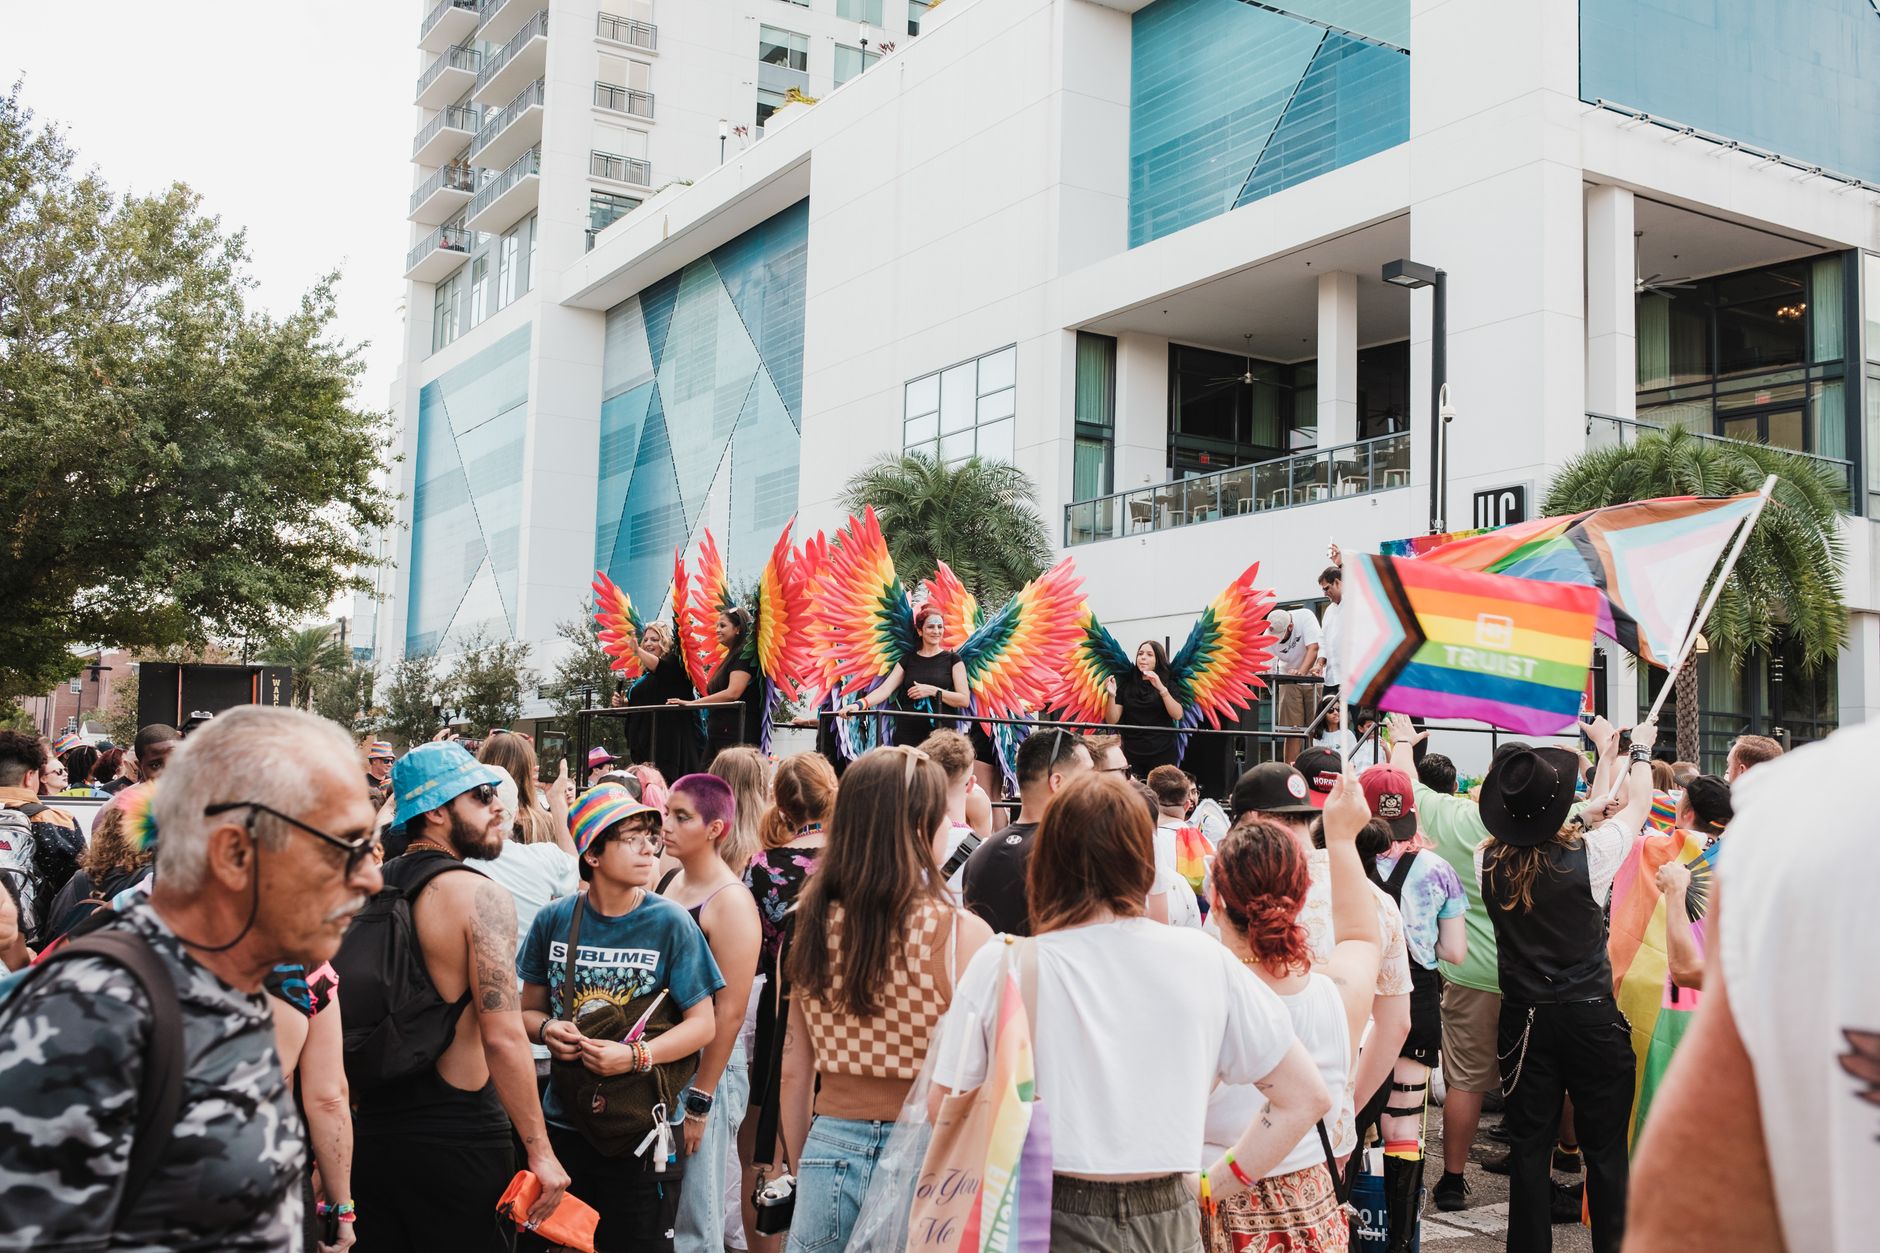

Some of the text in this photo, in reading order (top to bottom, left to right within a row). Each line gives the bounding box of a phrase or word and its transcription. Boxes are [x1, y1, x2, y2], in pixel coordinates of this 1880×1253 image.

[1443, 645, 1538, 678] TRUIST
[936, 1168, 979, 1207] You
[911, 1216, 959, 1247] Me
